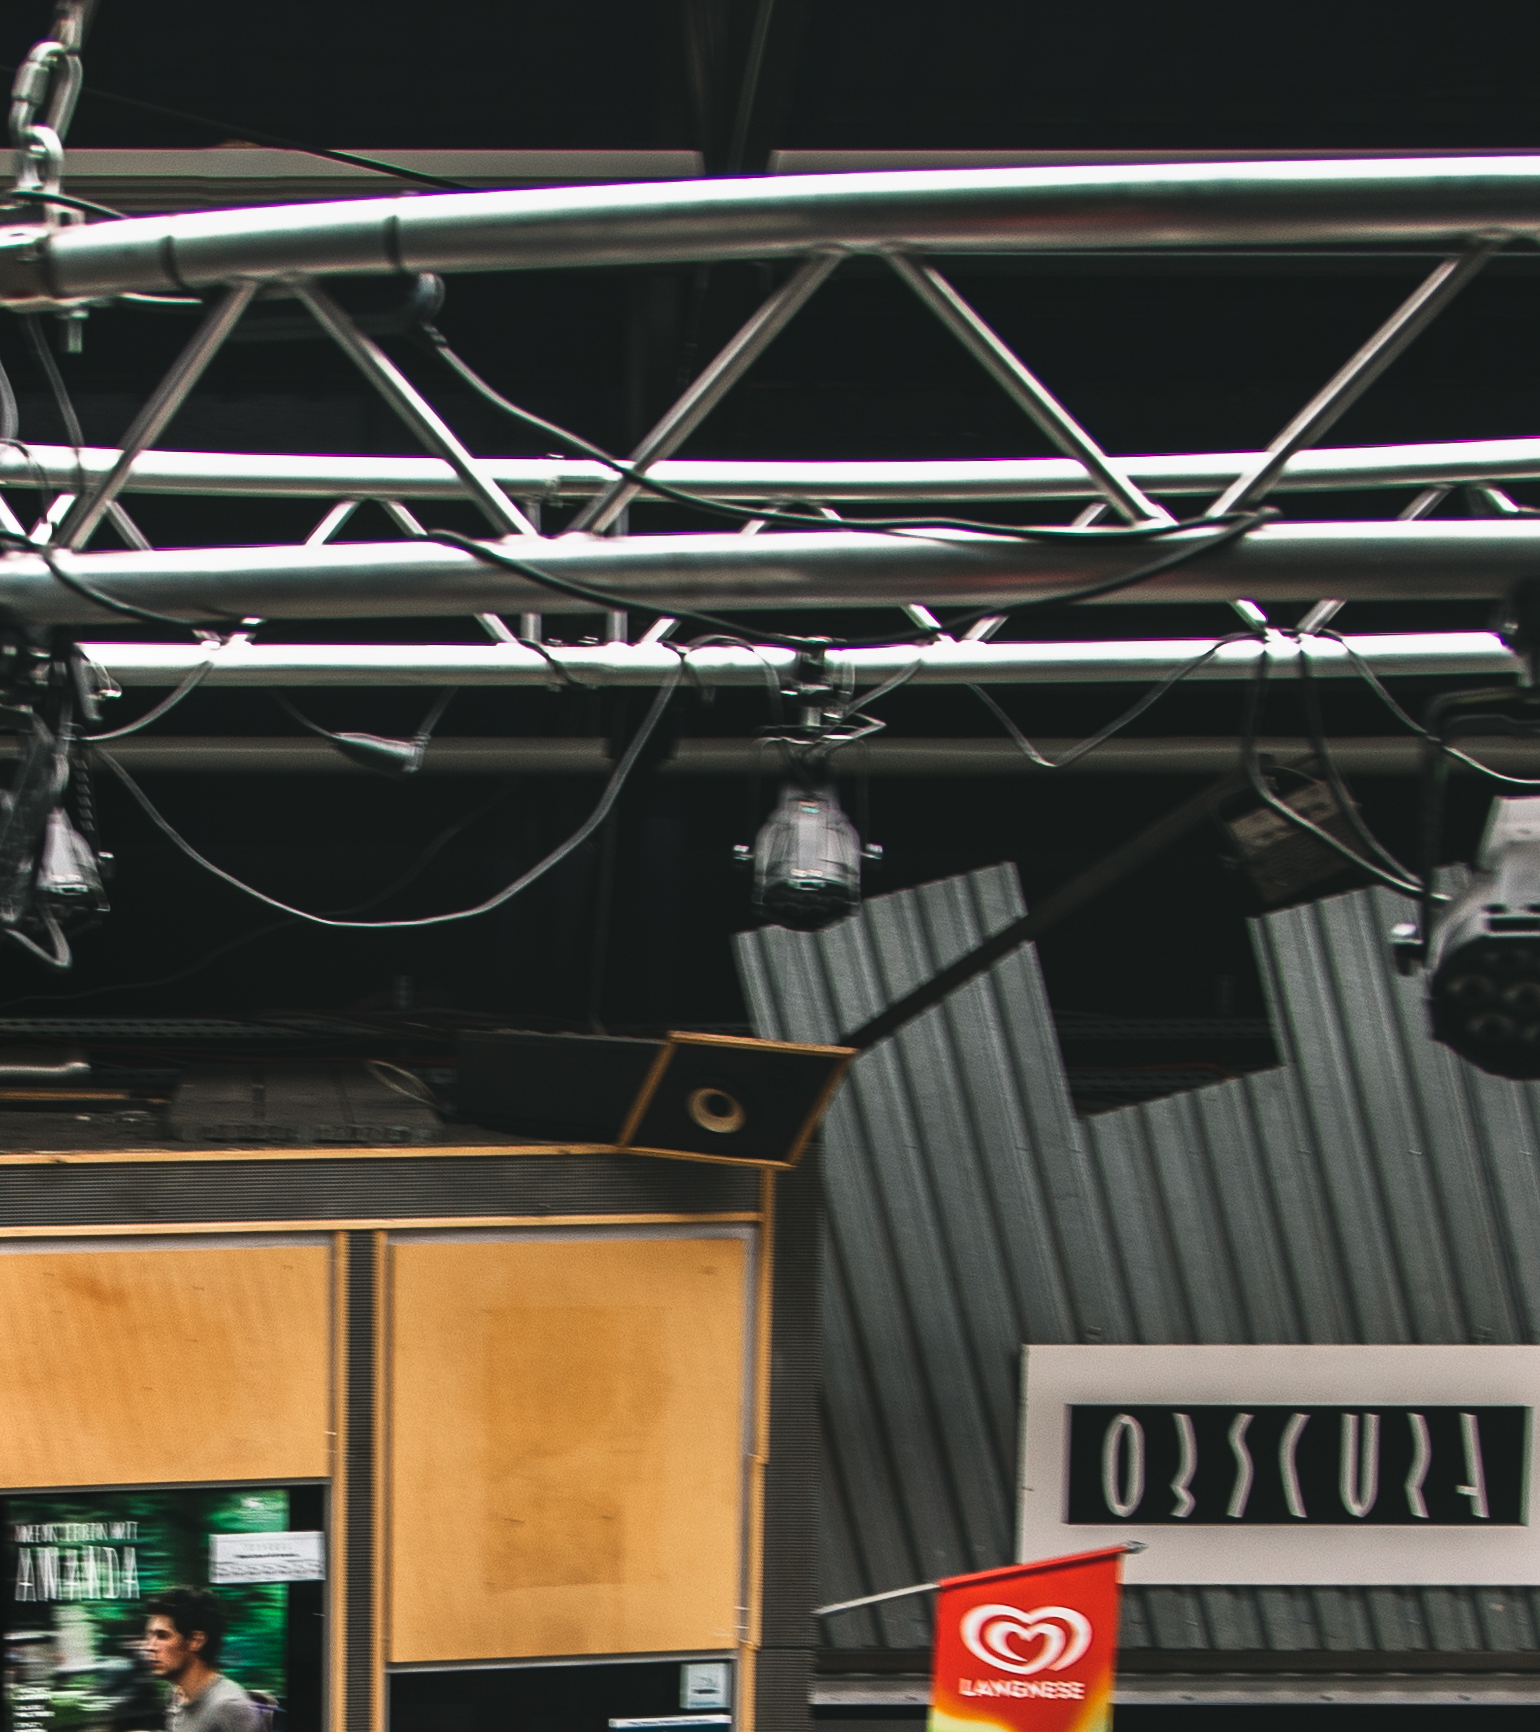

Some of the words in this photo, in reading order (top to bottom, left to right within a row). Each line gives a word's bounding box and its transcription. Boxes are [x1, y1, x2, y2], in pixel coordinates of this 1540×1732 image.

[1101, 1411, 1491, 1519] OBSCURA
[15, 1545, 141, 1602] AMANDA
[957, 1677, 1086, 1701] LANGNESE
